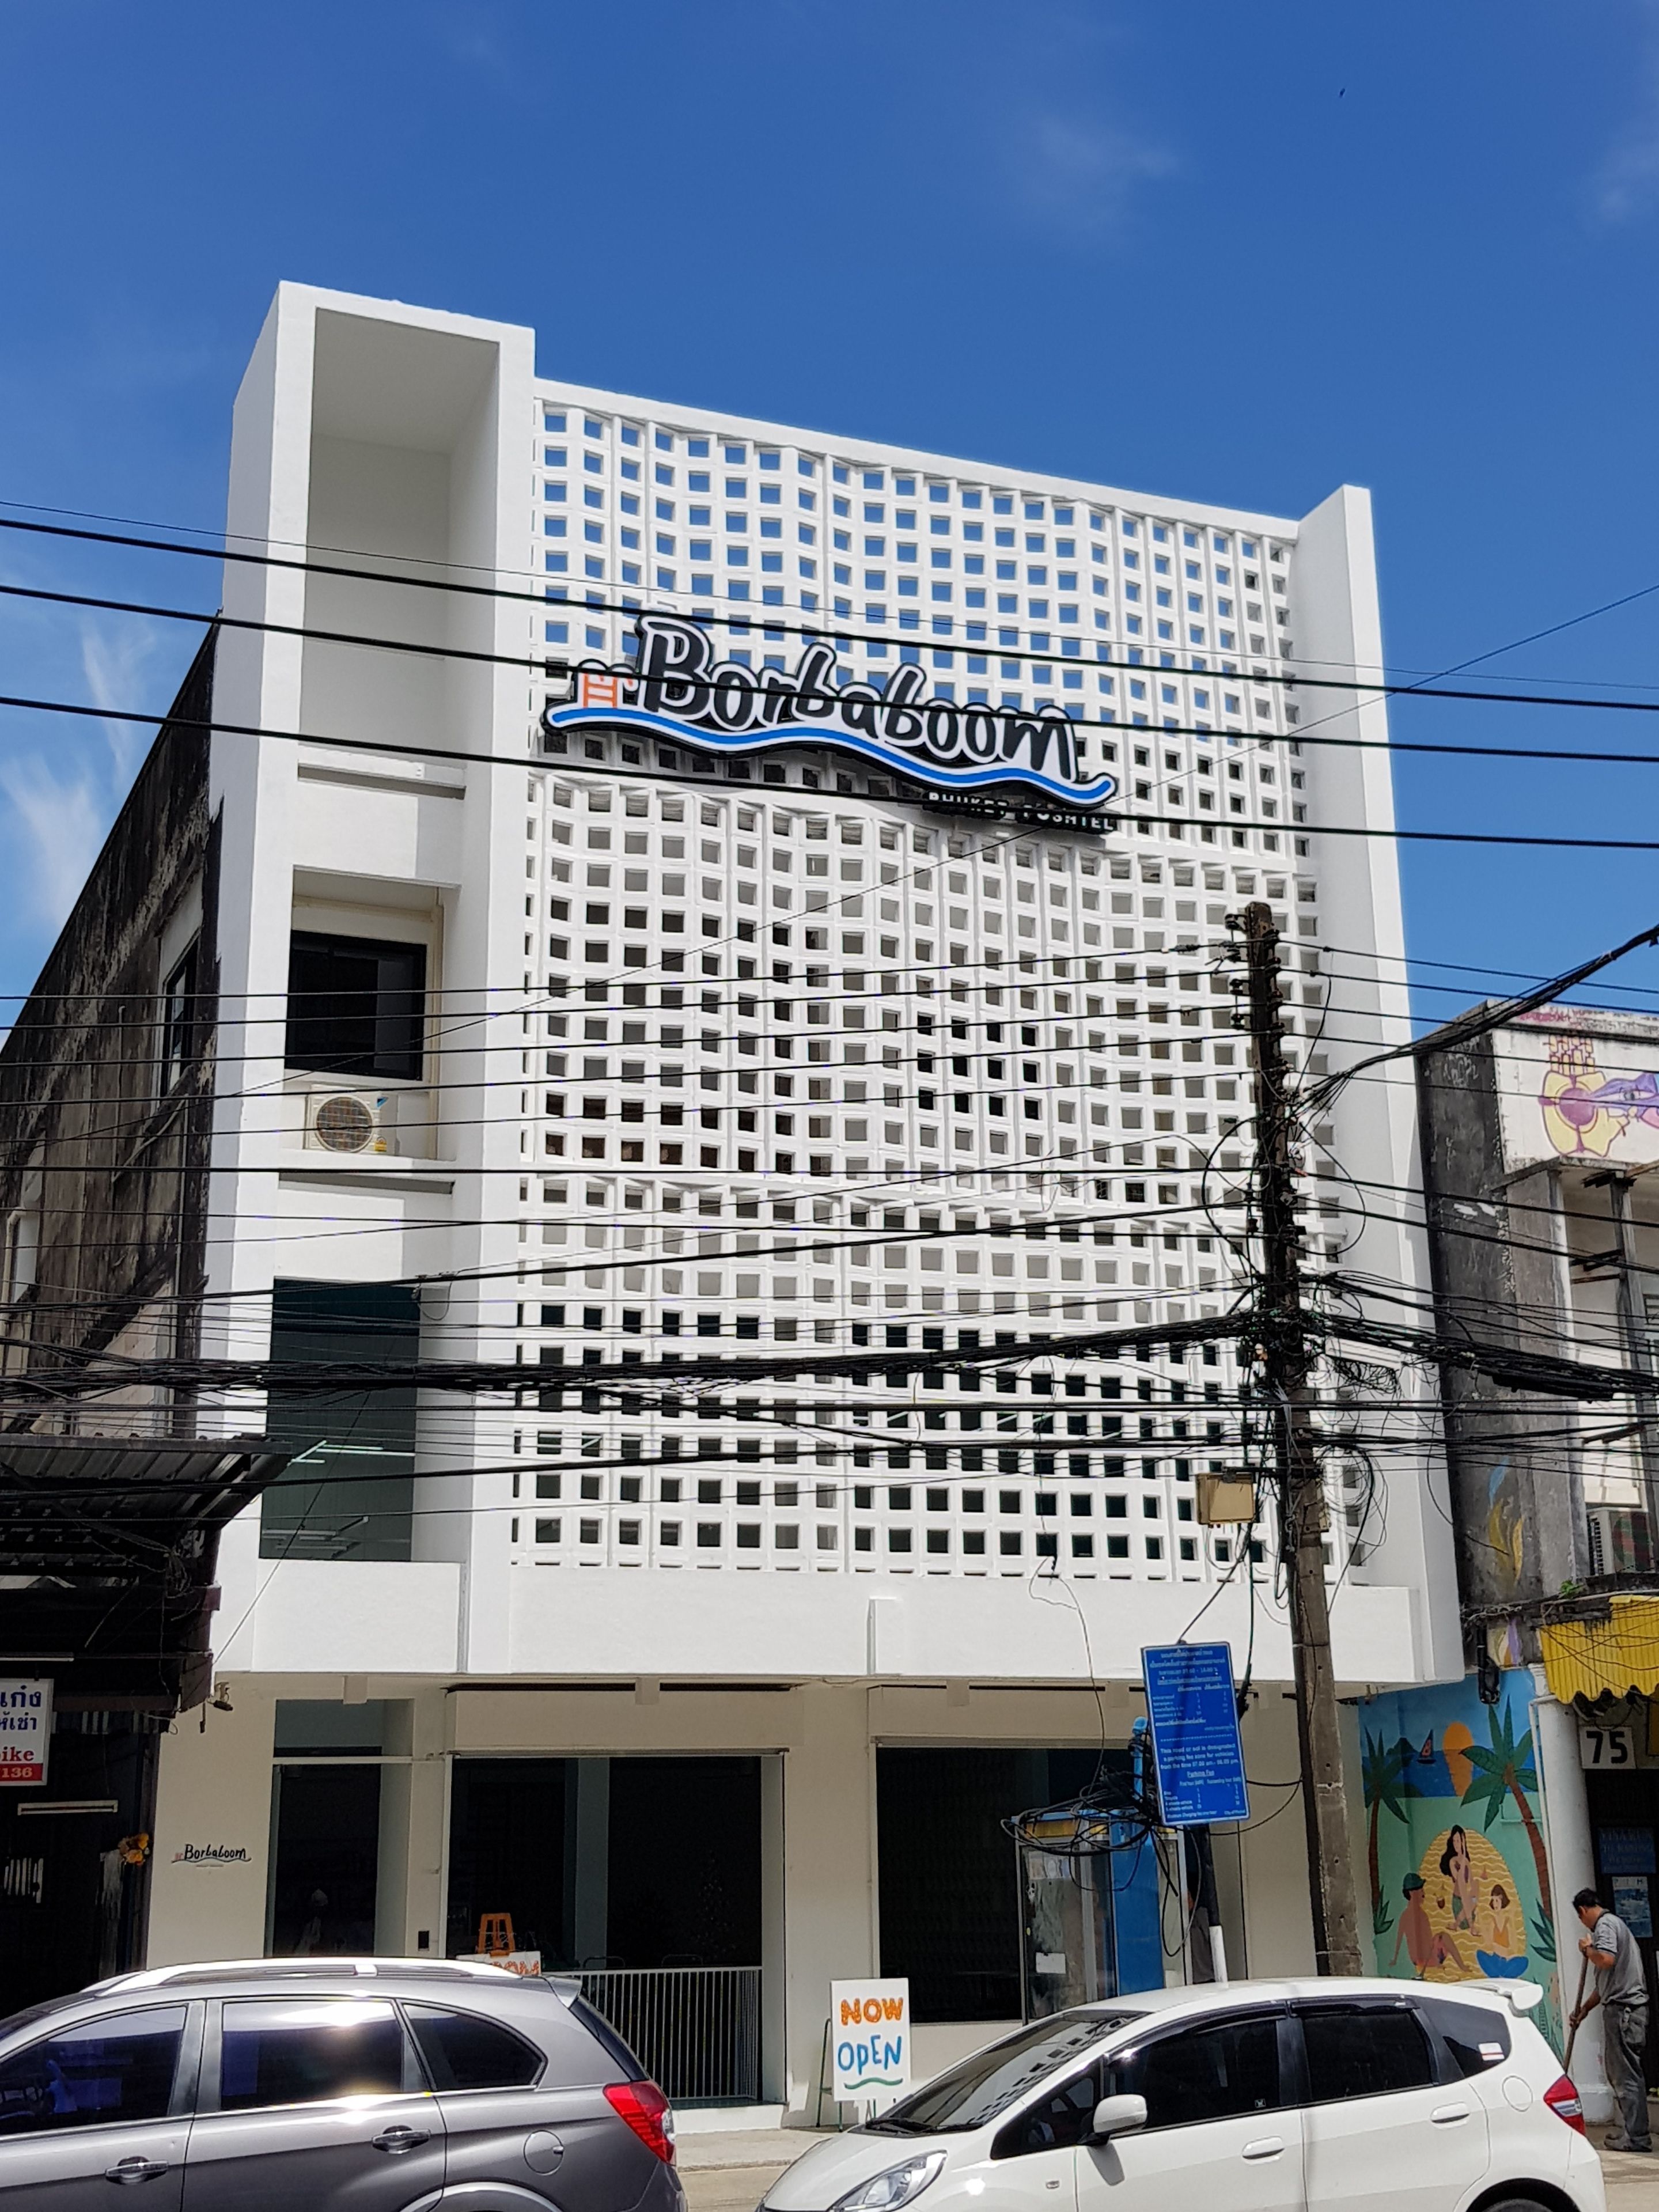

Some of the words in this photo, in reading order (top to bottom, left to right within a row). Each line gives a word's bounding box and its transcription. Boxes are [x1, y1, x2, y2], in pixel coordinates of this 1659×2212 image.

[638, 616, 1075, 782] Borbaboom
[0, 1747, 35, 1762] ike
[1586, 1730, 1628, 1764] 75
[841, 1998, 903, 2025] NOW
[838, 2034, 902, 2075] OPEN
